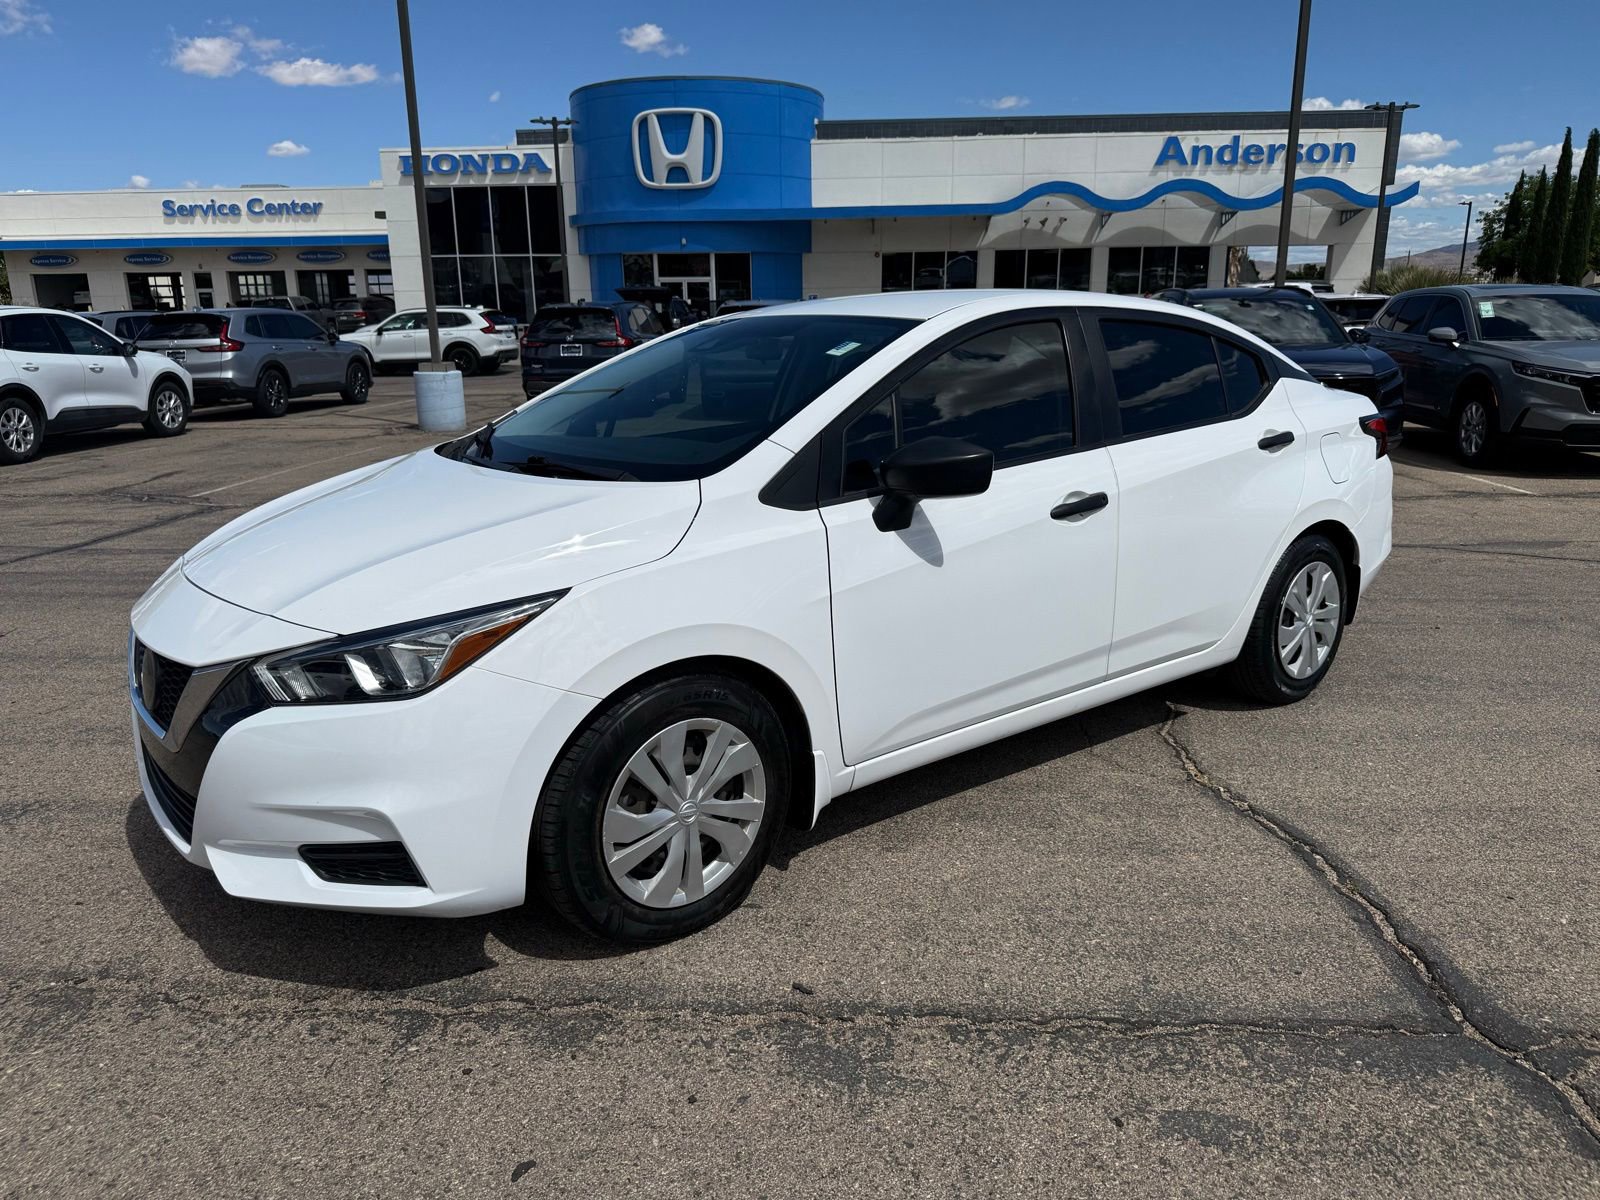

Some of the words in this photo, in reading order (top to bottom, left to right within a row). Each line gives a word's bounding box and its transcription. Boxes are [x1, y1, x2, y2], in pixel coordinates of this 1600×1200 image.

[399, 153, 552, 175] HONDA
[162, 199, 241, 217] Service
[247, 198, 323, 216] Center
